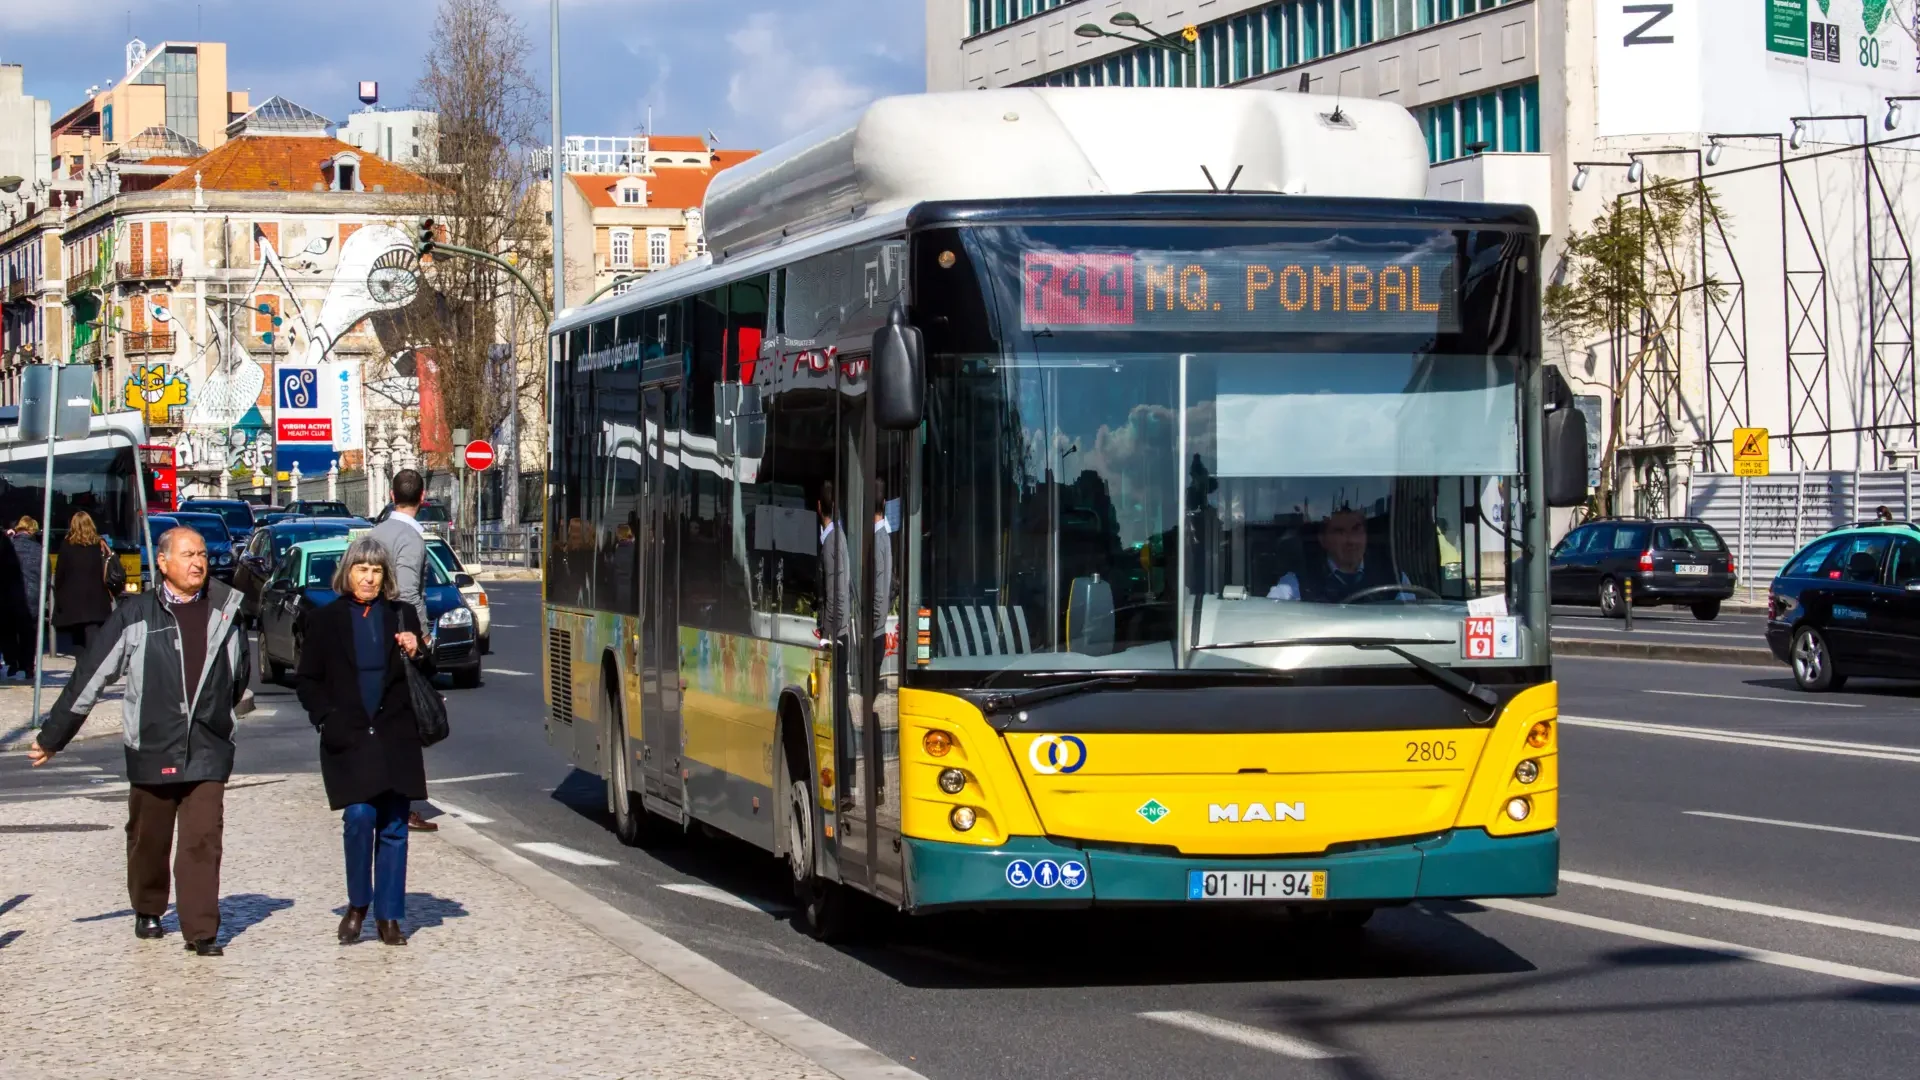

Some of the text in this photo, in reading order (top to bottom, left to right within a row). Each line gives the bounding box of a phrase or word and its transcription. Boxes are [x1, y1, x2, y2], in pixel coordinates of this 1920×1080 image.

[1859, 36, 1879, 68] 80
[1027, 263, 1440, 311] 744 MQ. POMBAL
[340, 385, 351, 443] BARCLAYS
[1468, 620, 1493, 636] 744
[1476, 640, 1485, 653] 9
[1406, 740, 1457, 762] 2805
[1140, 807, 1165, 816] CNG
[1208, 801, 1305, 823] MAN
